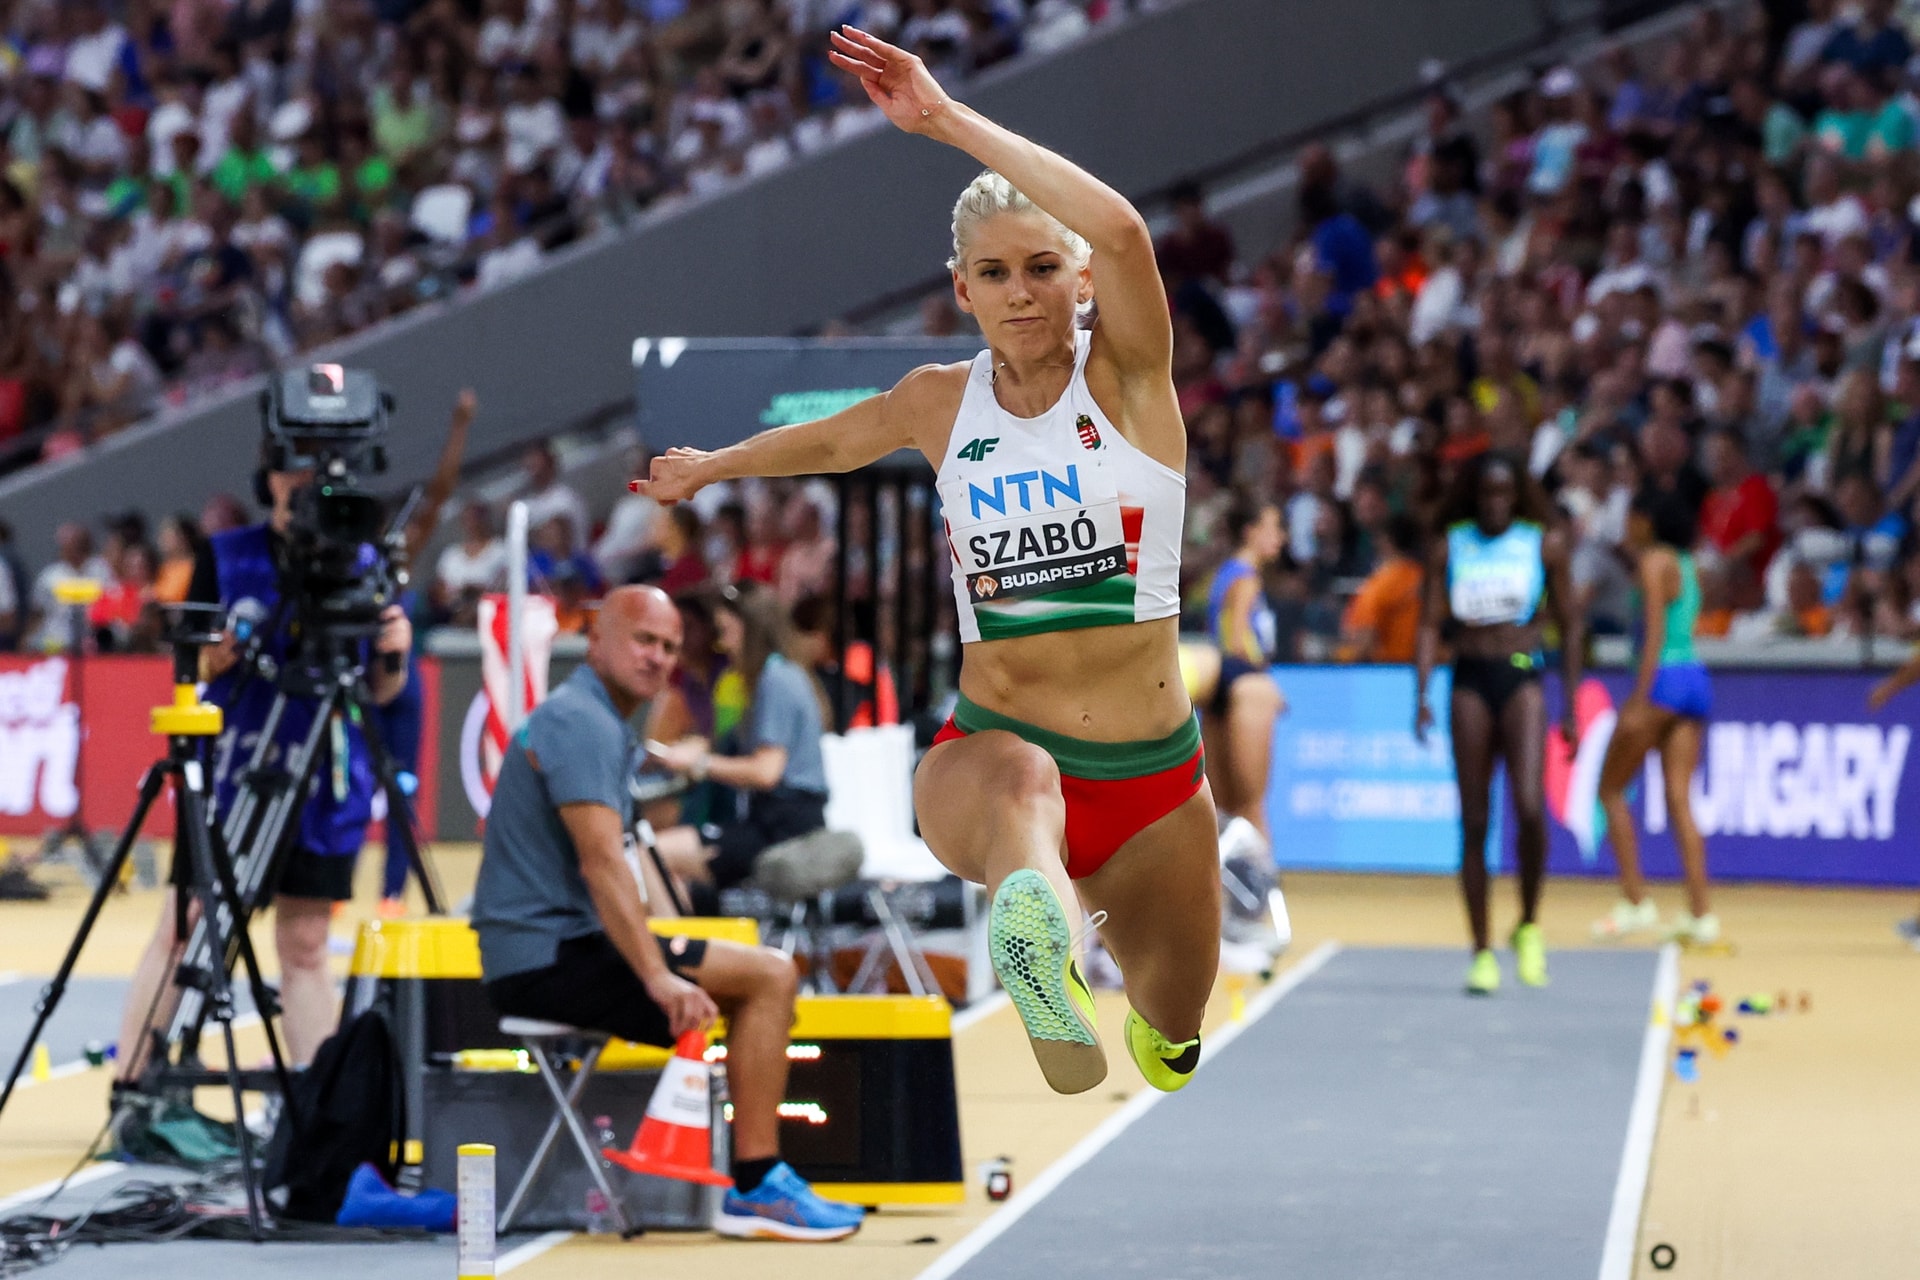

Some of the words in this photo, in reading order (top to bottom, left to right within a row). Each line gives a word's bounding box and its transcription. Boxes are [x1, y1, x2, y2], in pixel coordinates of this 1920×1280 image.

[957, 437, 1000, 461] 4F
[968, 464, 1082, 520] NTN
[969, 510, 1097, 568] SZABÓ
[1000, 561, 1095, 590] BUDAPEST
[1096, 556, 1117, 573] 23
